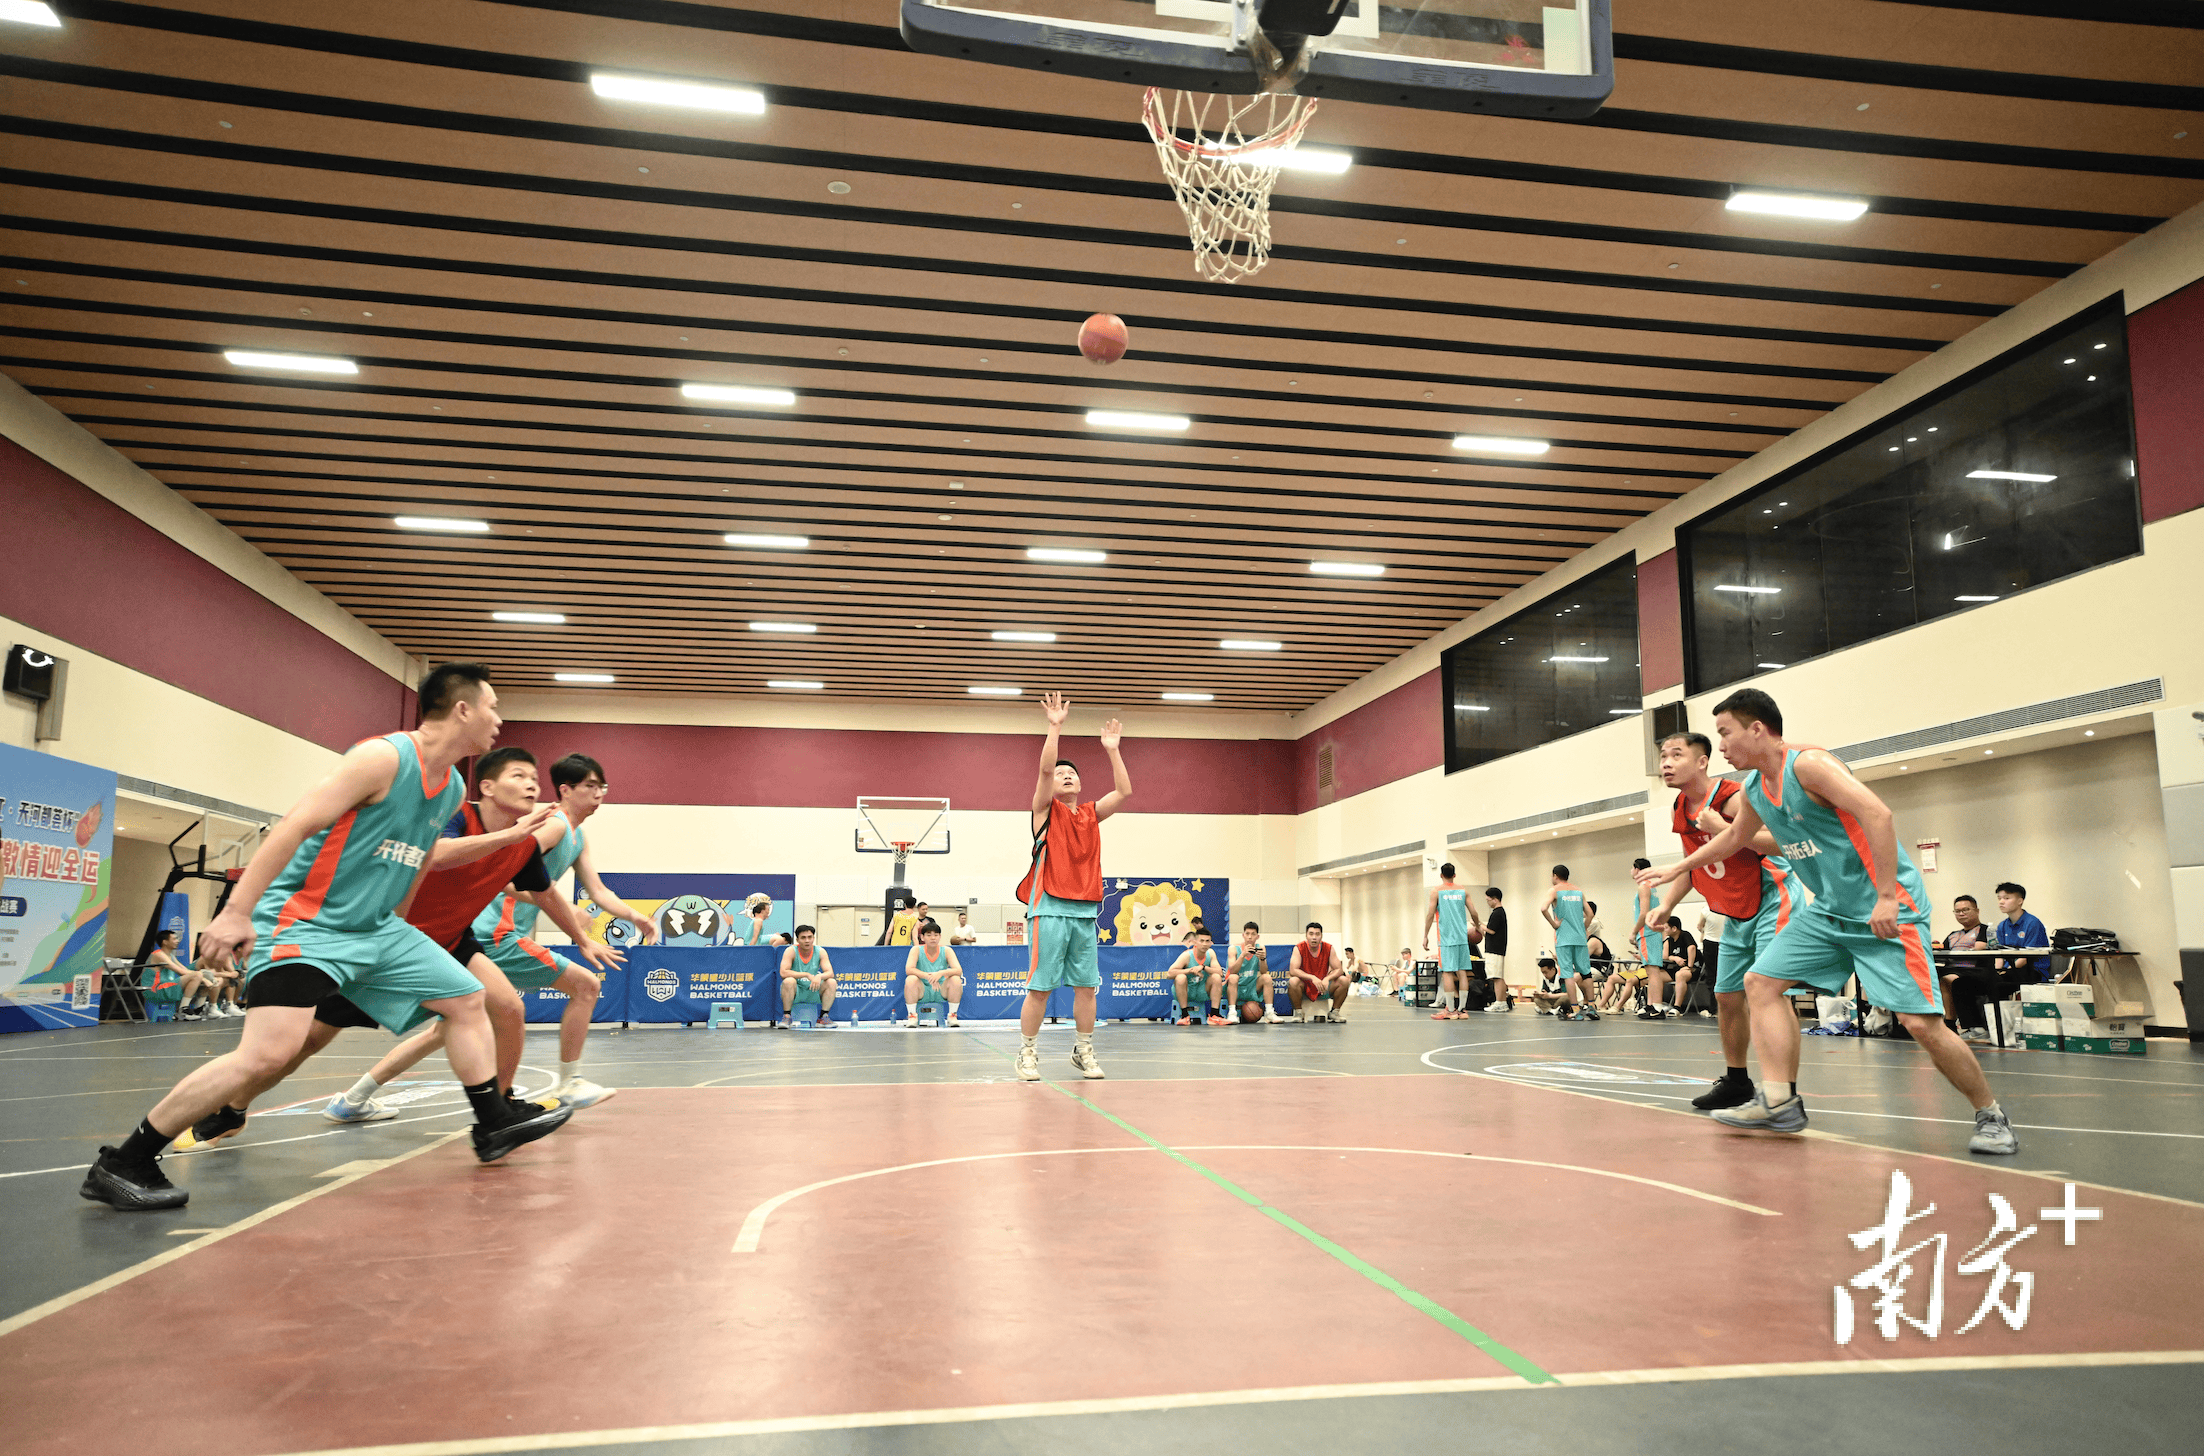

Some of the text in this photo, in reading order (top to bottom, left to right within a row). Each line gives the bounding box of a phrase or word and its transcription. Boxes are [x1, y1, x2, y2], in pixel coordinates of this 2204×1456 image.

[899, 925, 907, 936] 6
[690, 983, 744, 991] WALMONOS
[836, 982, 887, 990] WALMONOS
[1112, 981, 1161, 989] WALMONOS
[689, 991, 752, 999] BASKETBALL
[835, 990, 895, 998] BASKETBALL
[1112, 989, 1169, 997] BASKETBALL
